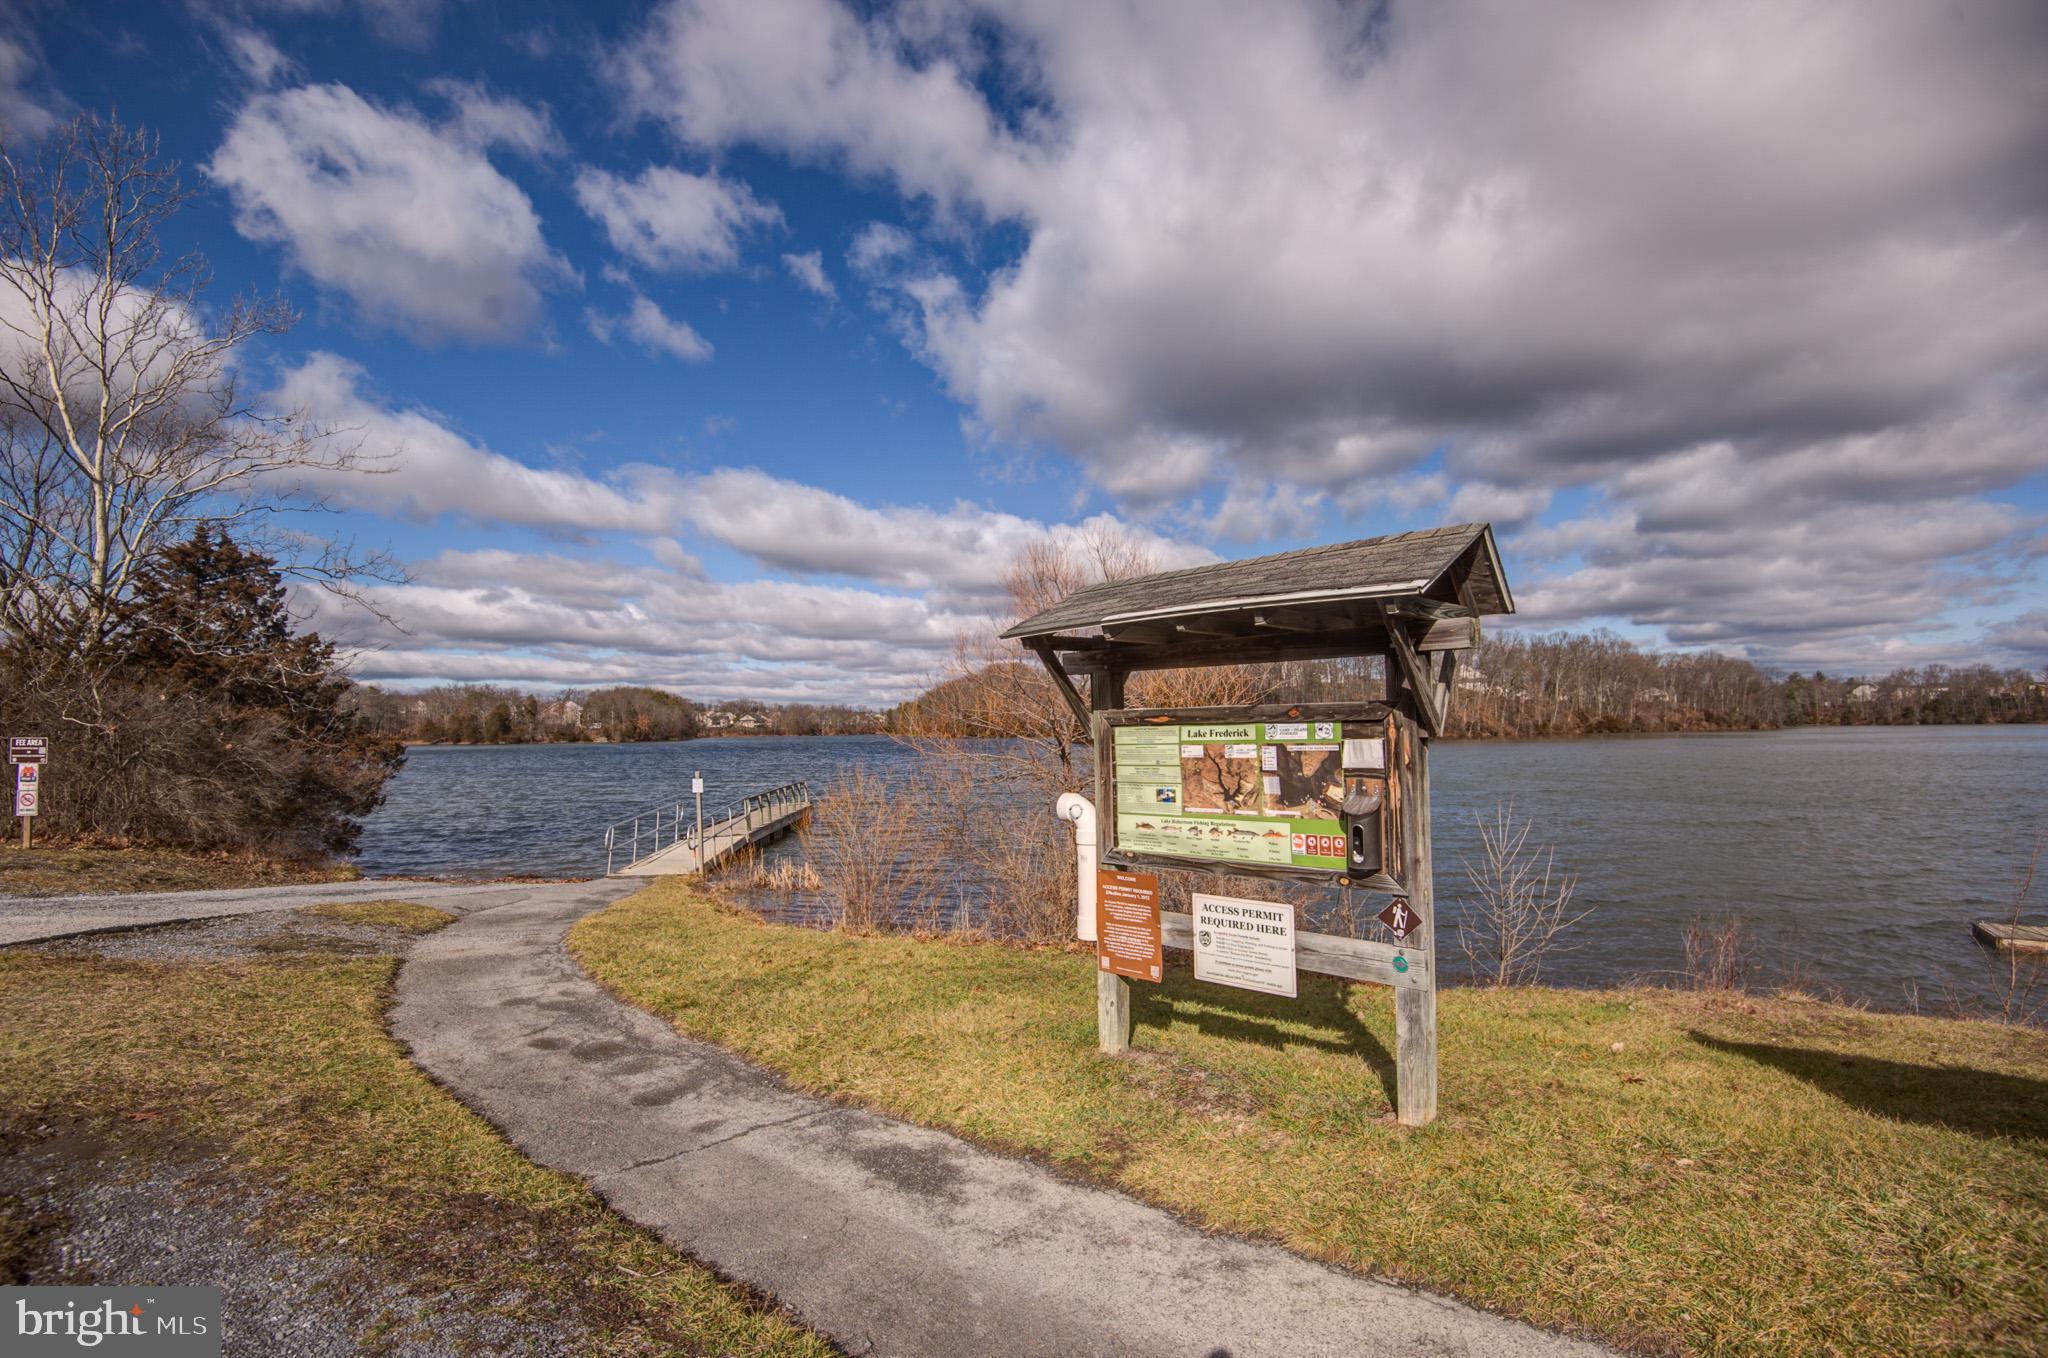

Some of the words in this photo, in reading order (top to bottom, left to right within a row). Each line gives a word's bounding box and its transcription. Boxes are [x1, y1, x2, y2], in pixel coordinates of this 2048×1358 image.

[1188, 729, 1207, 738] Lake
[1209, 728, 1249, 738] Frederick
[1202, 904, 1240, 916] ACCESS
[1242, 908, 1284, 922] PERMIT
[1200, 916, 1254, 932] REQUIRED
[1256, 924, 1287, 936] HERE
